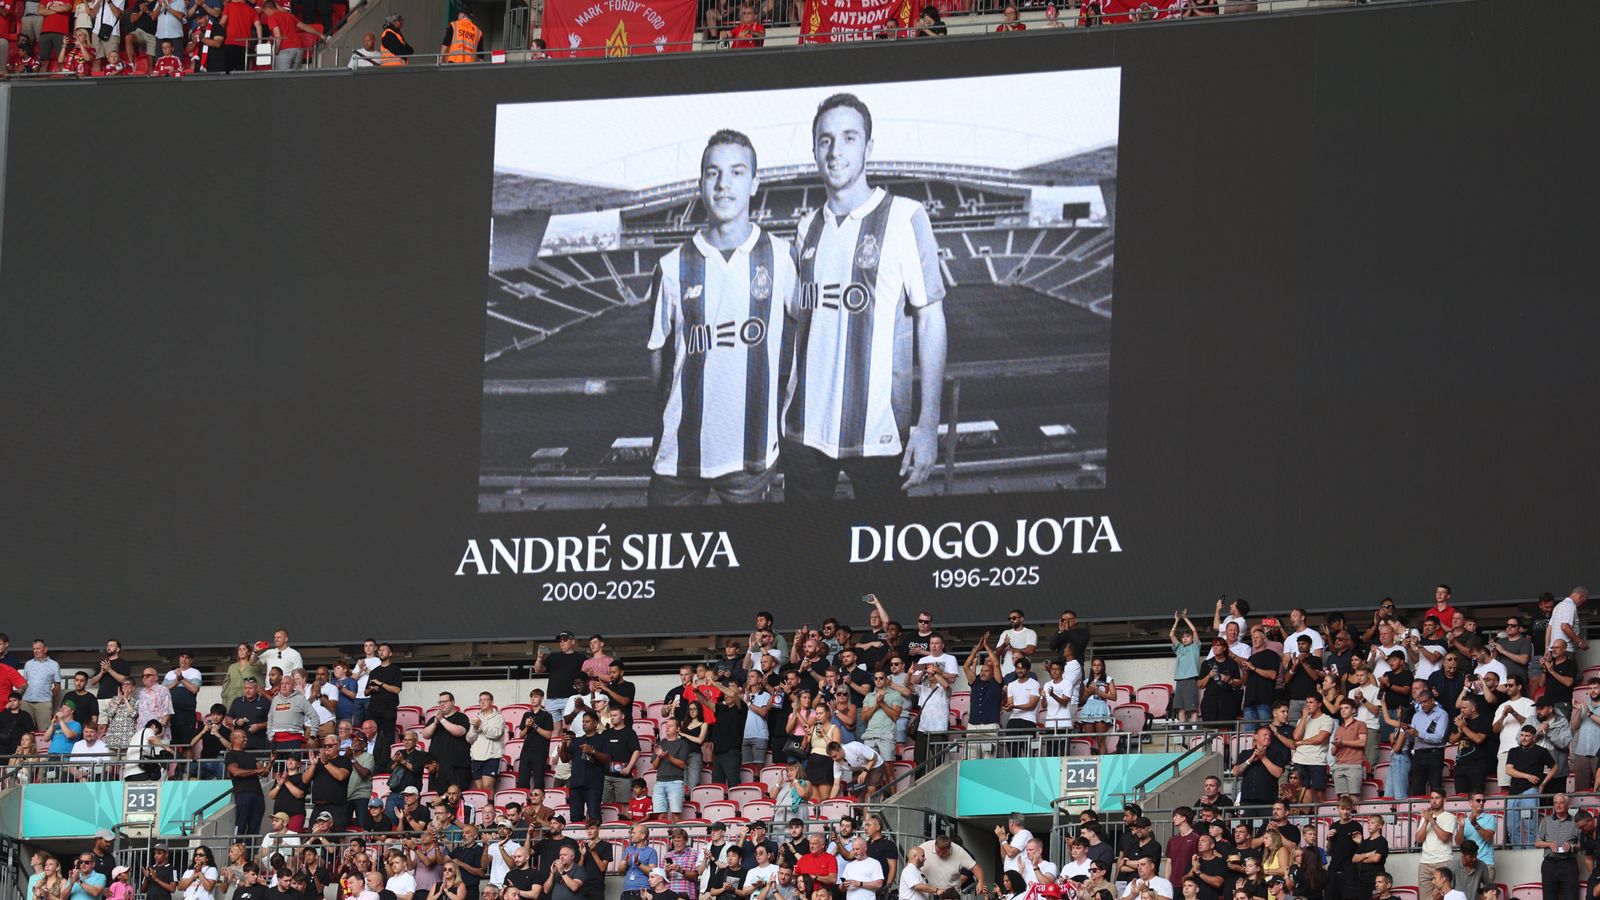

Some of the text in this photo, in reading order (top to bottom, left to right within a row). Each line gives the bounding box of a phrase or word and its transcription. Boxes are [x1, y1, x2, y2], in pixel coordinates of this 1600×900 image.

[575, 3, 603, 27] MARK
[643, 7, 665, 30] FORD
[829, 6, 891, 26] ANTHONY
[687, 316, 766, 354] MEO
[454, 523, 740, 576] ANDRÉ SILVA
[849, 515, 1122, 563] DIOGO JOTA
[932, 565, 1040, 589] 1996-2025
[542, 580, 656, 602] 2000-2025
[1067, 768, 1096, 783] 214
[128, 793, 156, 807] 213
